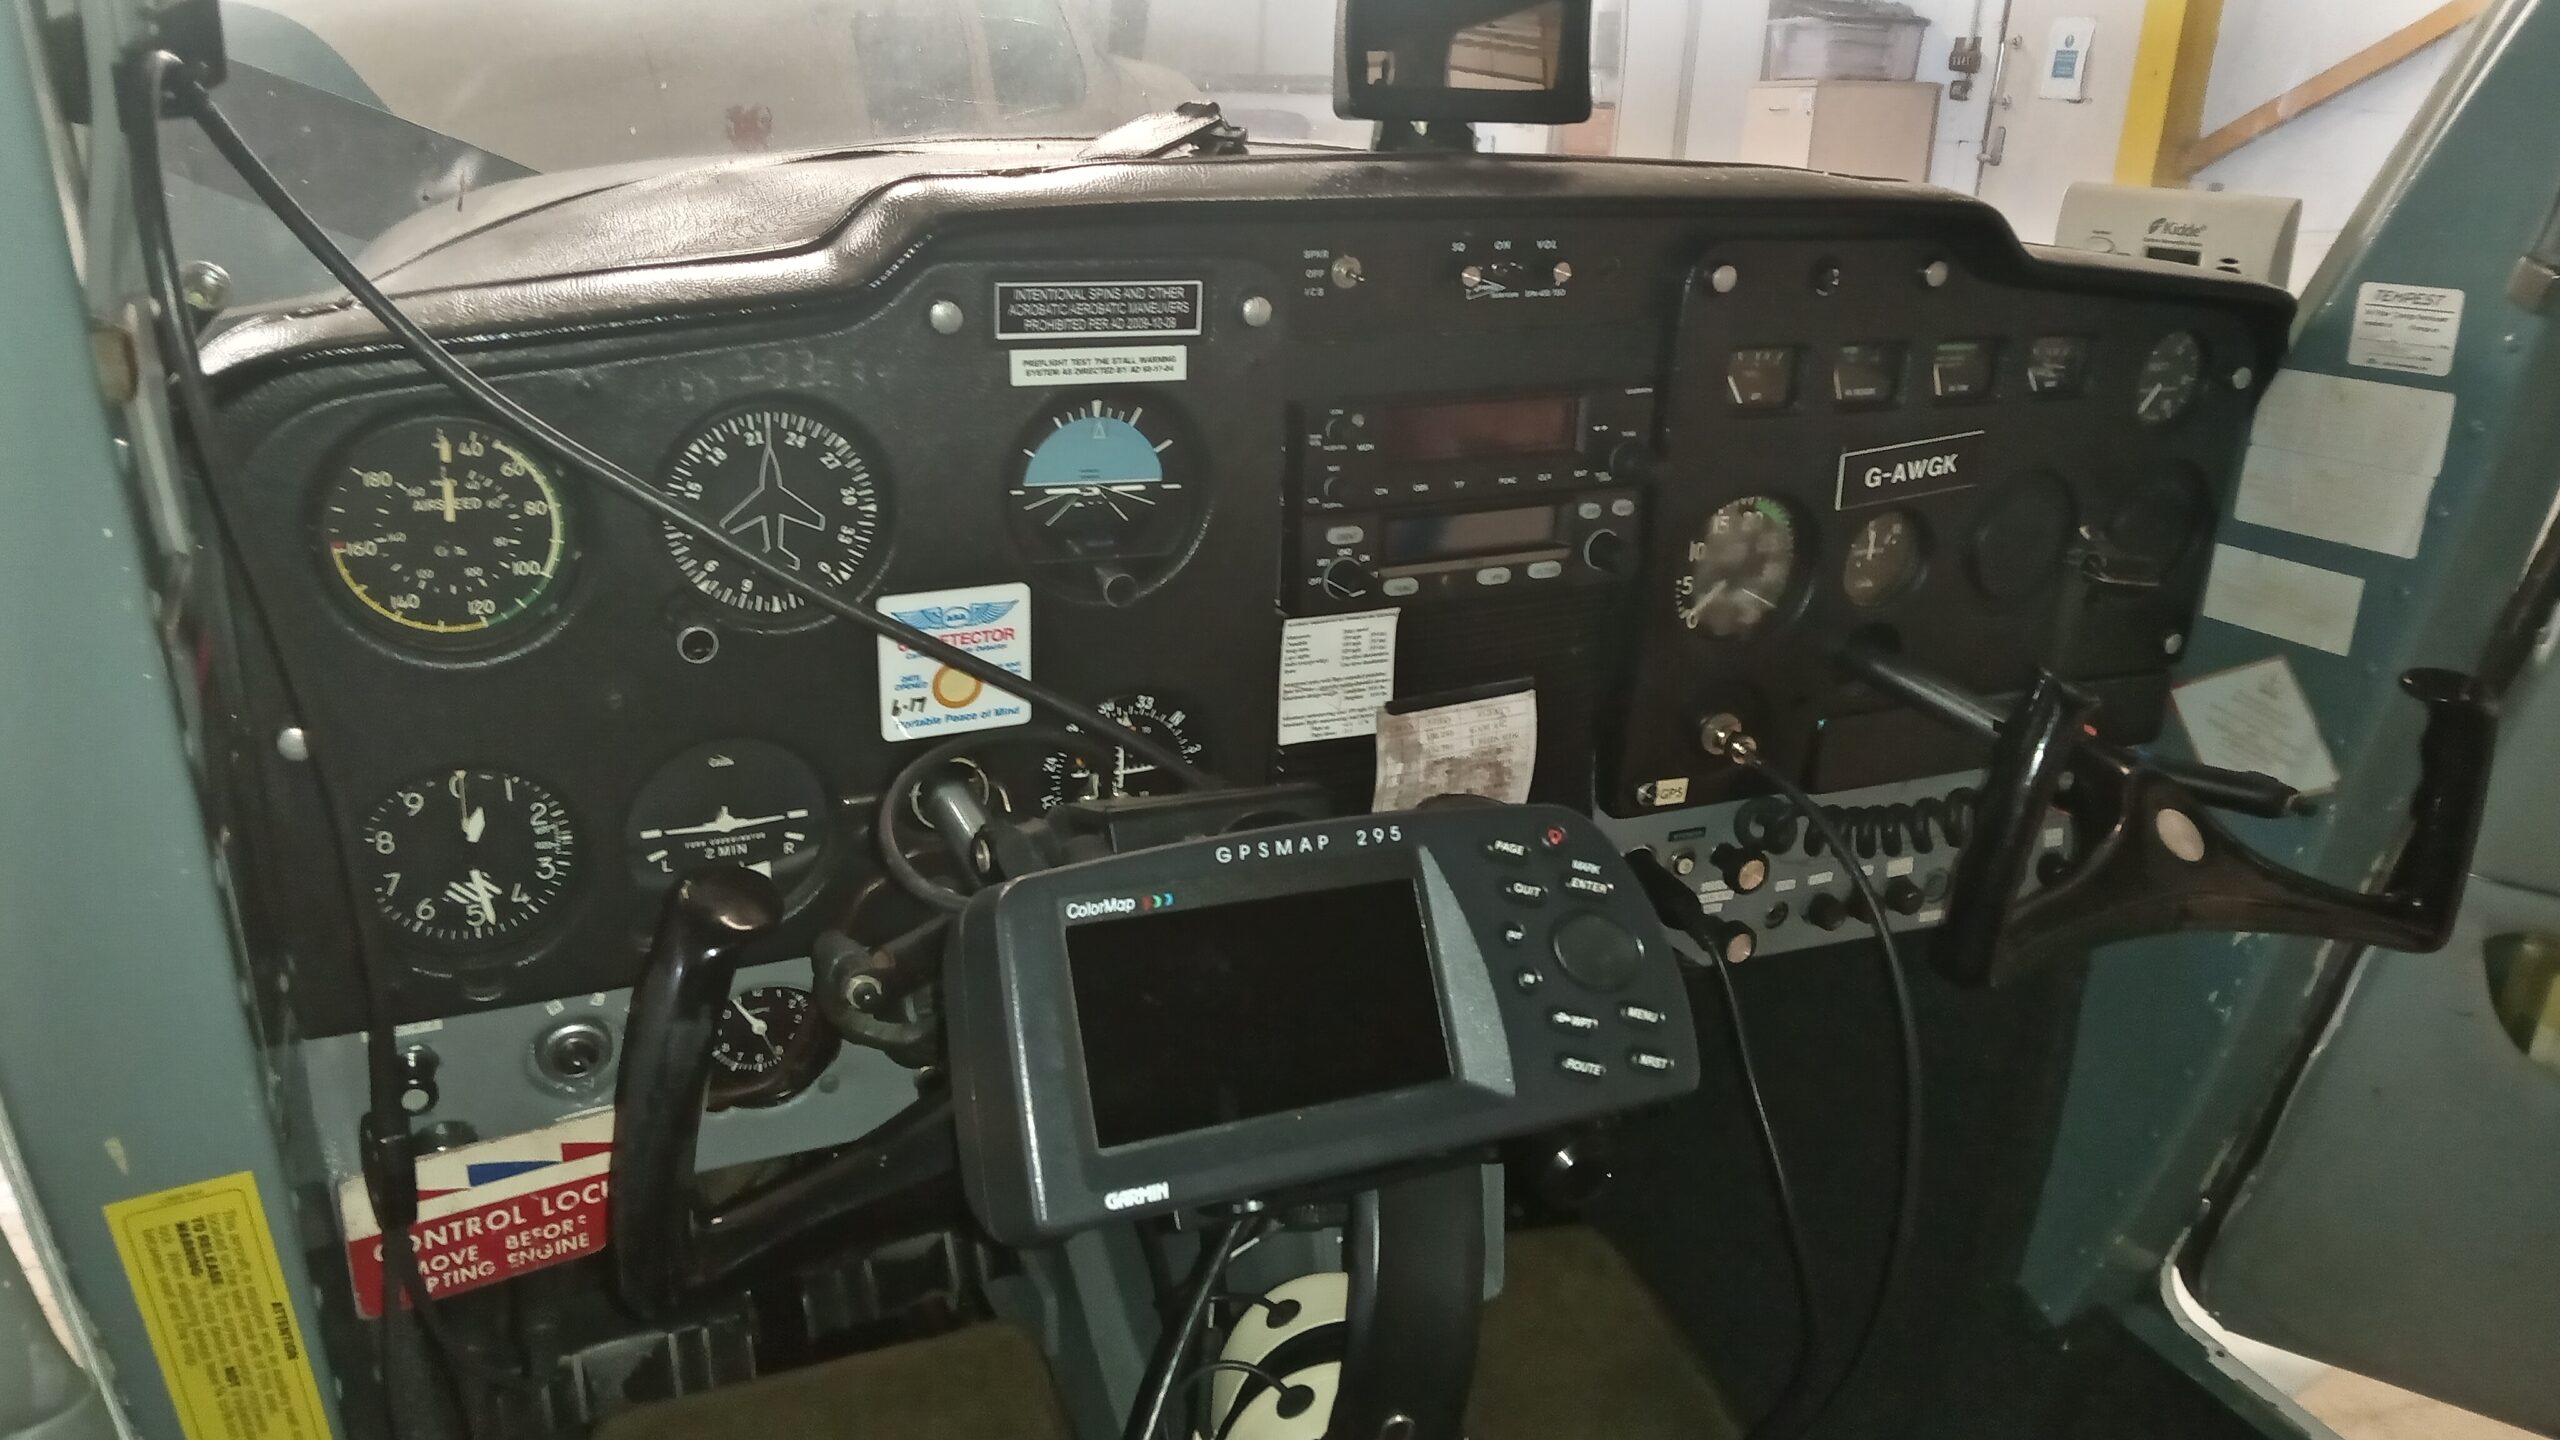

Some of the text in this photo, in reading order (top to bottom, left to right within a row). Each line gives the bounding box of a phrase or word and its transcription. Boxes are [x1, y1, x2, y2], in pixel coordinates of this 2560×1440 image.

[2163, 222, 2201, 237] Kidde
[1536, 239, 1558, 250] VOL
[1013, 286, 1185, 301] INTENTIONAL SPINS AND OTHER
[1128, 301, 1191, 315] MANEUVERS
[1023, 316, 1177, 331] PROHIBITED PER AD 2009-10-09
[1070, 358, 1093, 366] TEST
[1094, 357, 1110, 365] THE
[1111, 356, 1136, 365] STALL
[1138, 355, 1177, 364] WARNING
[1074, 366, 1115, 376] DIRECTED
[743, 429, 765, 448] 21
[783, 430, 808, 449] 24
[705, 446, 728, 468] 18
[819, 450, 842, 471] 27
[500, 460, 525, 478] 60
[1864, 453, 1959, 489] G-AWGK
[362, 470, 394, 488] 180
[683, 480, 704, 501] 15
[839, 486, 859, 507] 30
[523, 500, 548, 516] 80
[837, 524, 856, 545] 33
[346, 546, 378, 557] 160
[1689, 541, 1706, 562] 10
[511, 560, 542, 576] 100
[1680, 575, 1694, 595] 5
[390, 593, 421, 610] 140
[467, 598, 496, 615] 120
[894, 681, 929, 691] OPENED
[944, 711, 978, 723] Peace
[980, 710, 993, 720] of
[994, 706, 1021, 718] Mind
[1659, 786, 1684, 800] GPS
[402, 791, 425, 818] 9
[529, 802, 548, 827] 2
[374, 830, 396, 855] 8
[717, 843, 748, 858] MIN
[783, 841, 796, 856] R
[1215, 825, 1403, 864] GPSMAP 295
[1494, 839, 1525, 856] PAGE
[535, 856, 556, 880] 3
[660, 859, 675, 874] L
[383, 872, 401, 897] 7
[511, 883, 532, 904] 4
[1513, 882, 1542, 898] QUIT
[1570, 877, 1608, 895] ENTER
[415, 897, 436, 921] 6
[465, 904, 487, 928] 5
[1066, 897, 1136, 920] ColorMap
[1627, 1006, 1659, 1023] MENU
[1563, 1057, 1604, 1076] ROUTE
[1104, 1181, 1170, 1210] GARMIN
[175, 1221, 204, 1278] WARNING
[506, 1231, 591, 1268] ENGINE
[196, 1234, 224, 1285] RELEASE
[271, 1302, 299, 1361] ATTENTION
